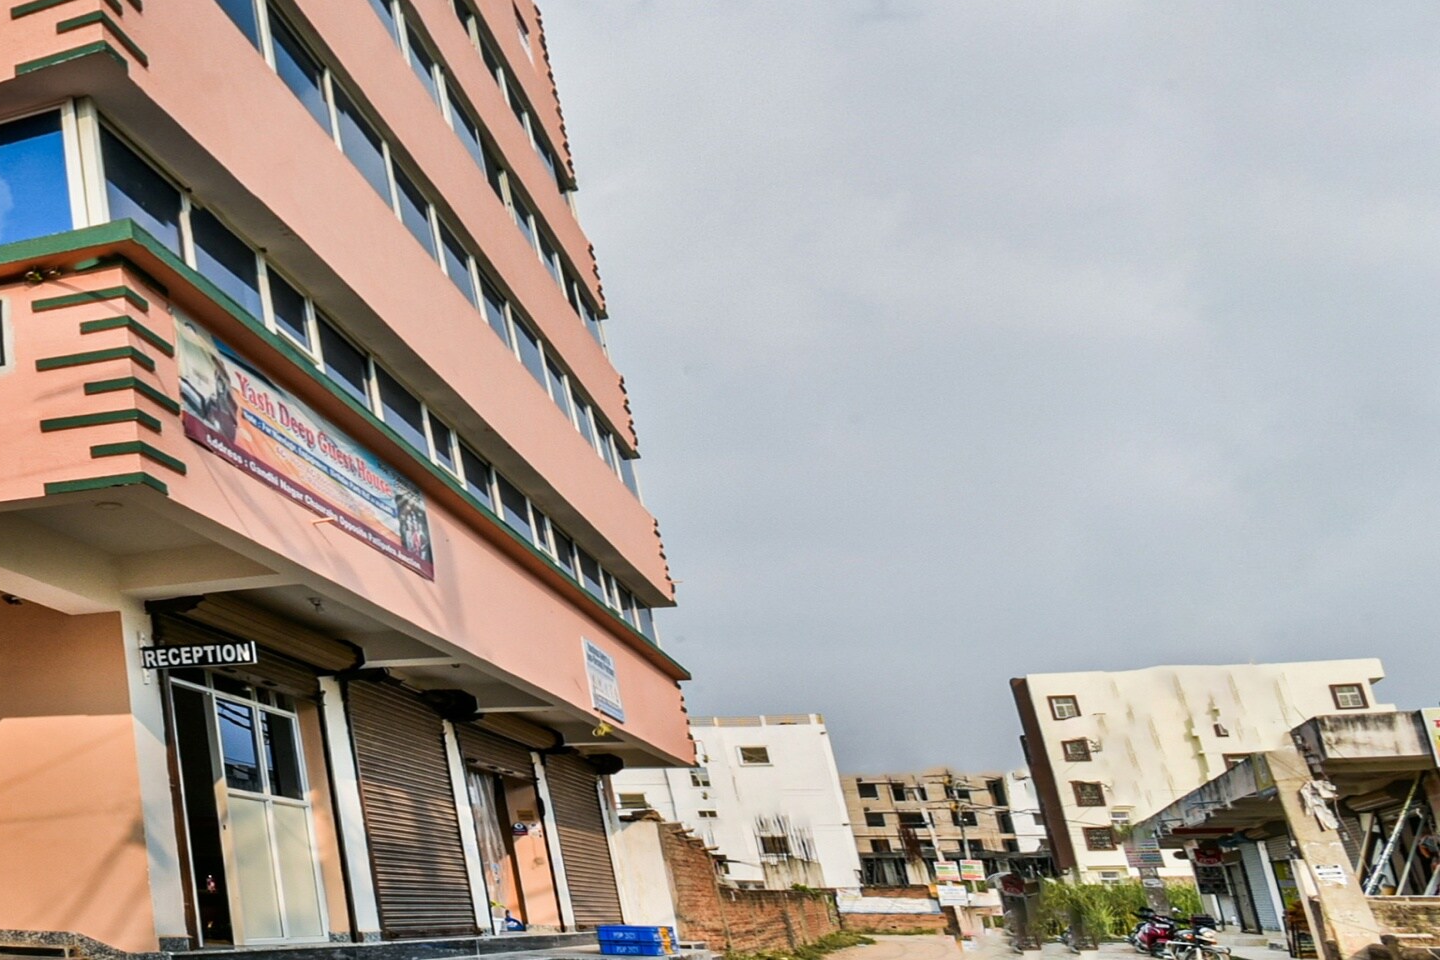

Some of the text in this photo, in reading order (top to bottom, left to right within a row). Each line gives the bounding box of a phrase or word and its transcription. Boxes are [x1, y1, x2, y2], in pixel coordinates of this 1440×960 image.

[235, 371, 276, 420] Yash
[277, 401, 316, 450] Deep
[317, 430, 357, 473] Guest
[356, 456, 393, 497] House
[144, 643, 251, 668] RECEPTION
